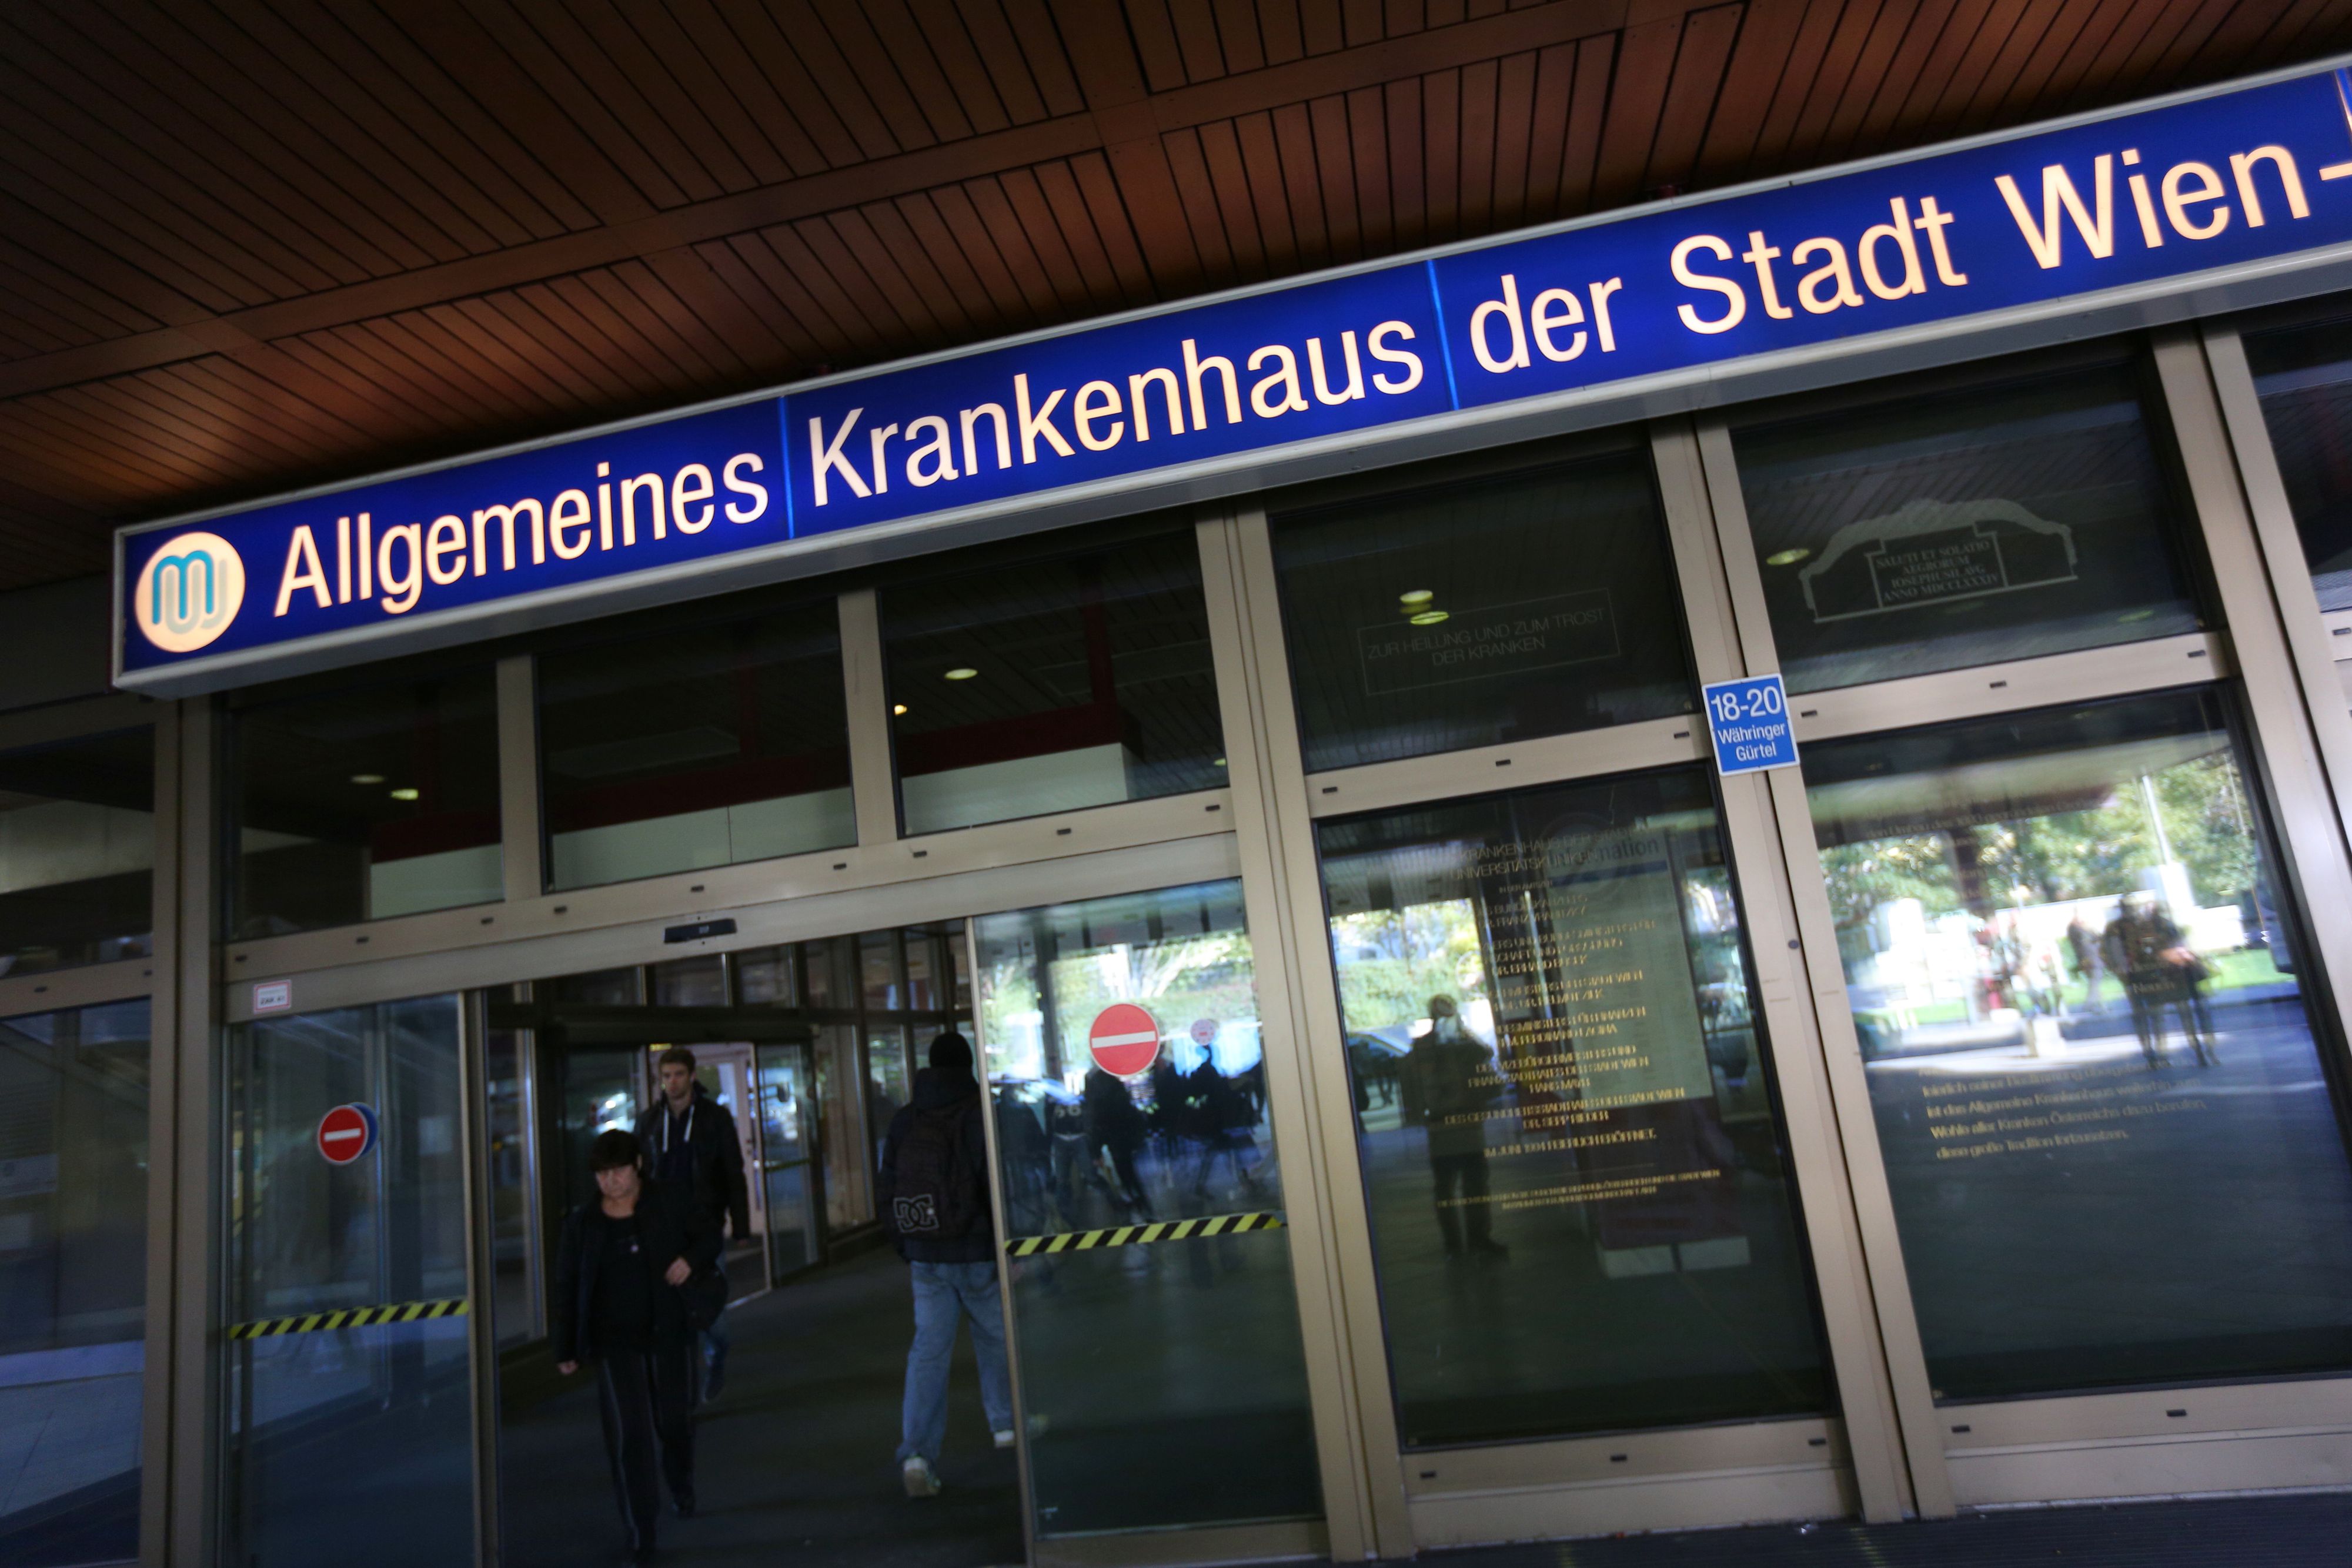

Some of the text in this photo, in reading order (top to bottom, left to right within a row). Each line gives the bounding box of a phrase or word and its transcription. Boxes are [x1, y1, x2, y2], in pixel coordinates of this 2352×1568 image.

[273, 452, 769, 618] Allgemeines
[808, 319, 1424, 507] Krankenhaus
[1469, 273, 1623, 374] der
[1670, 196, 1968, 335] Stadt
[1368, 607, 1606, 660] ZUR HEILUNG UND ZUM TROST
[1432, 634, 1545, 666] DER KRANKEN
[1710, 686, 1782, 722] 18-20
[1718, 723, 1786, 745] Währinger
[1735, 741, 1777, 762] Gürtel
